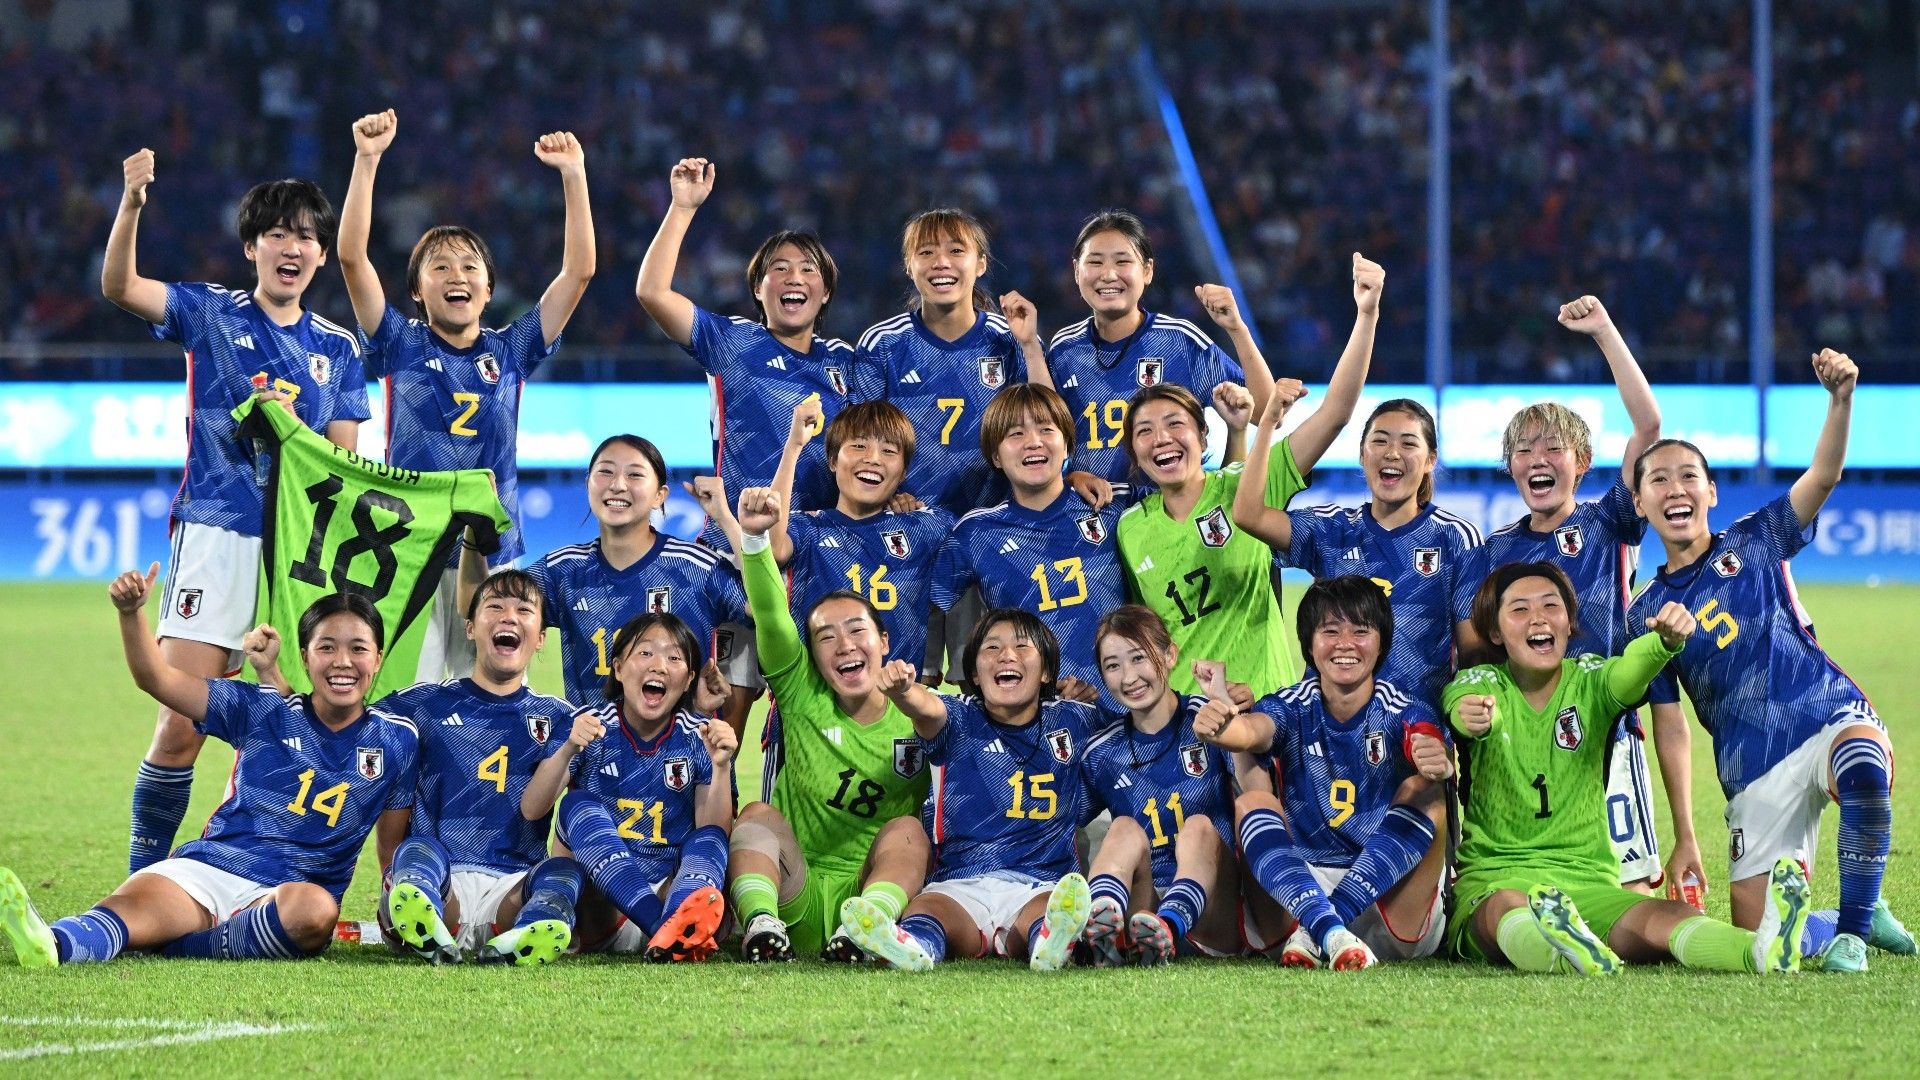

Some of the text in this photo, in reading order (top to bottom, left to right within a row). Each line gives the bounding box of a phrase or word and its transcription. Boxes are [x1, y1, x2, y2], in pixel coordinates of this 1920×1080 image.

[450, 392, 479, 437] 2
[937, 398, 965, 445] 7
[1081, 399, 1130, 449] 19
[289, 472, 416, 604] 18
[846, 565, 897, 611] 16
[1031, 557, 1088, 611] 13
[1164, 565, 1219, 626] 12
[1695, 598, 1740, 650] 5
[590, 628, 621, 676] 1
[477, 746, 509, 793] 4
[824, 767, 886, 819] 18
[287, 769, 350, 828] 14
[1006, 771, 1058, 820] 15
[1141, 792, 1187, 847] 11
[1329, 778, 1357, 829] 9
[1530, 773, 1554, 820] 1
[616, 798, 668, 845] 21
[1841, 851, 1887, 863] JAPAN
